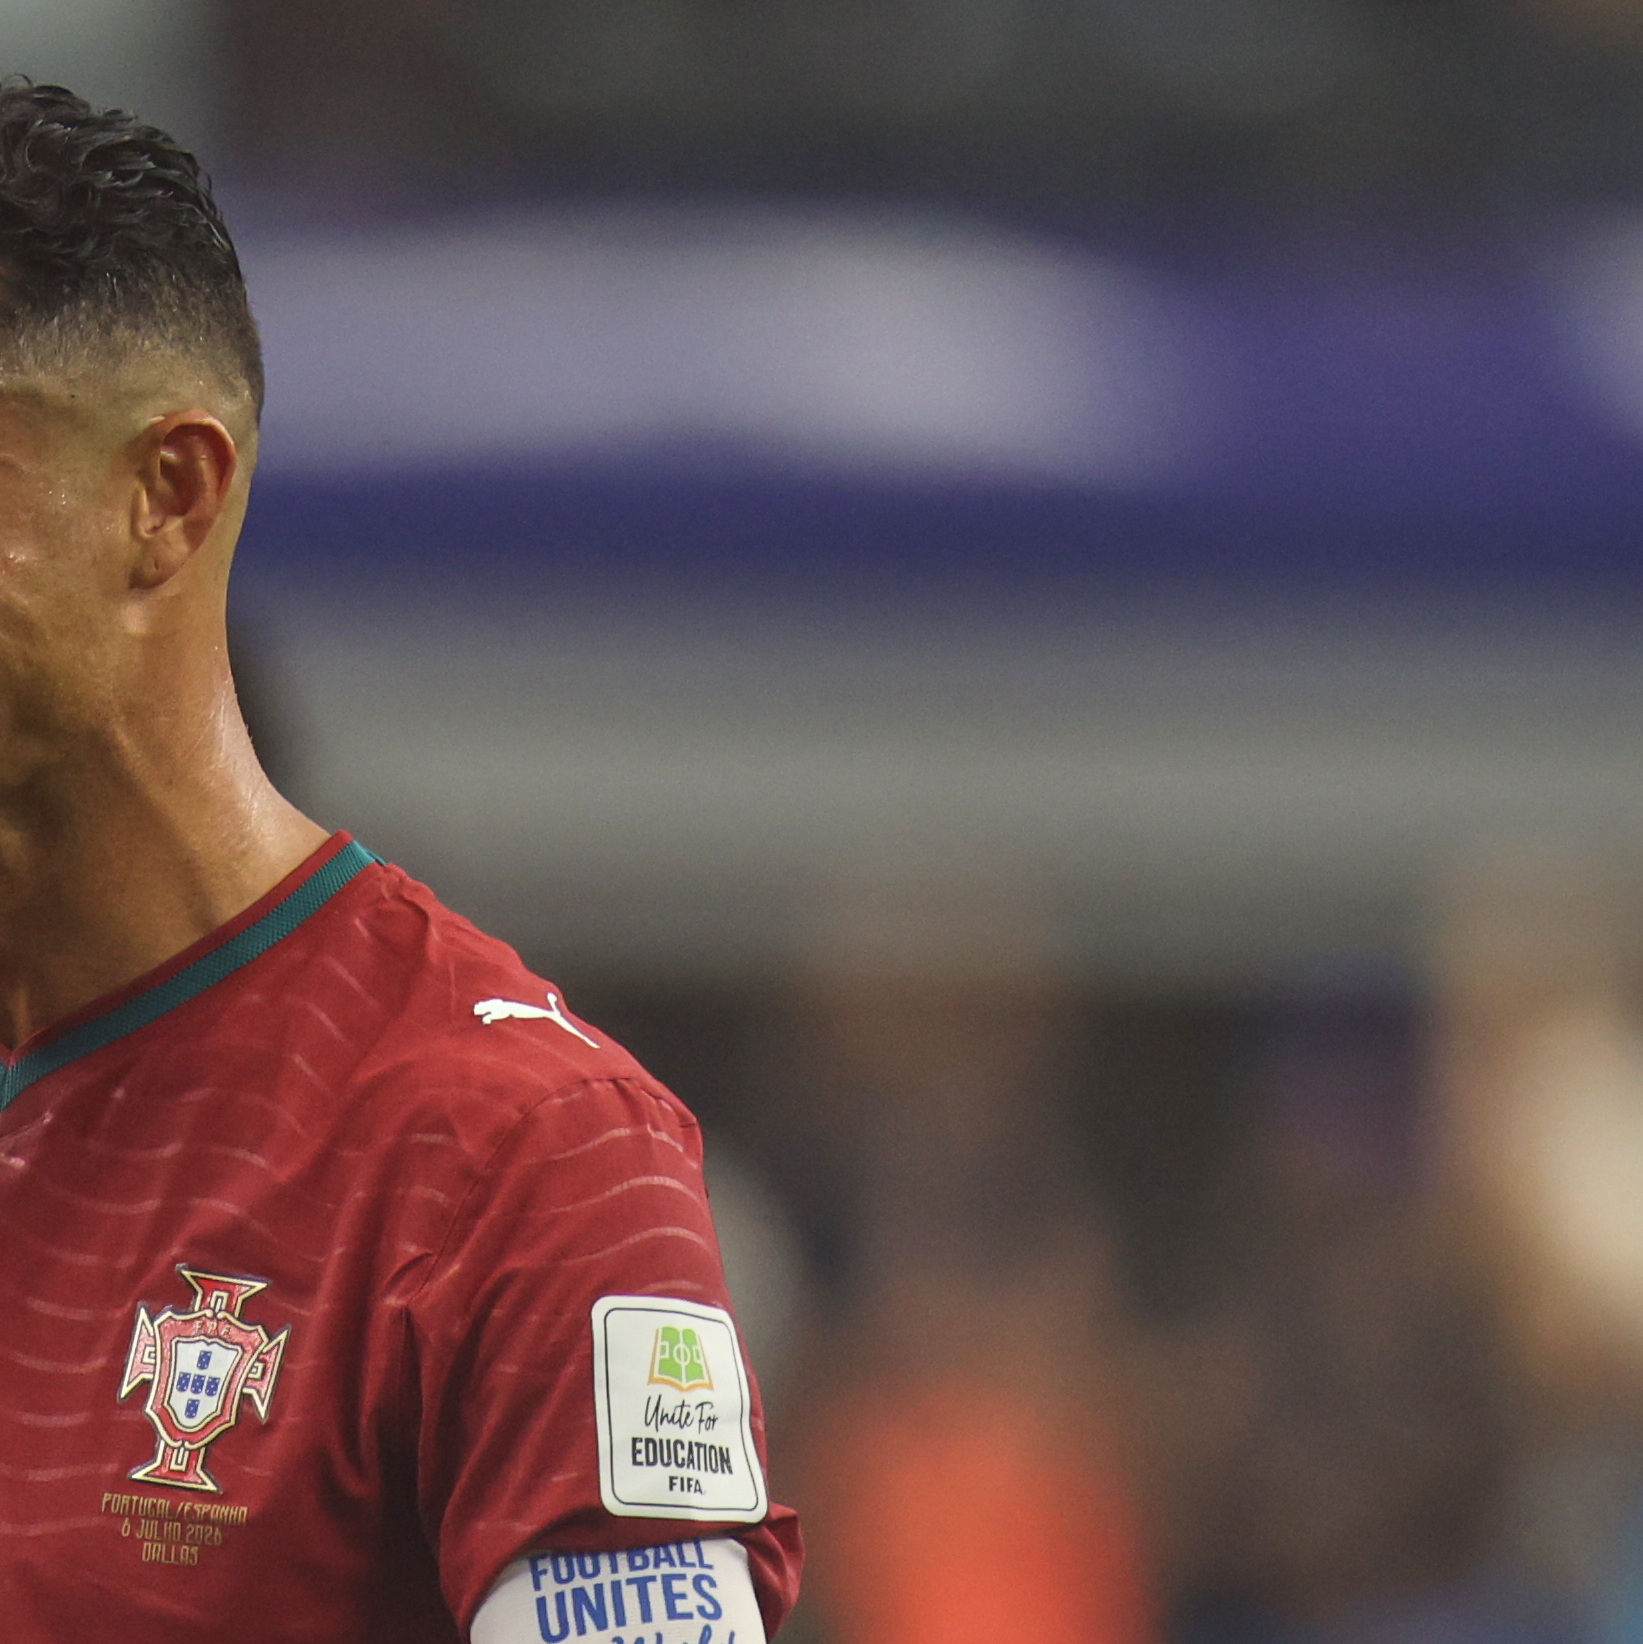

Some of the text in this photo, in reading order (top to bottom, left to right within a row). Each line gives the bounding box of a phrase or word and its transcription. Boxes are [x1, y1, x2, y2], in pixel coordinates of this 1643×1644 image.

[644, 1393, 719, 1434] Unite For
[631, 1437, 733, 1475] EDUCATION
[668, 1475, 704, 1495] FIFA
[121, 1517, 223, 1546] 6 JULHO 2026
[142, 1542, 199, 1566] DALLAS
[535, 1573, 723, 1644] UNITES
